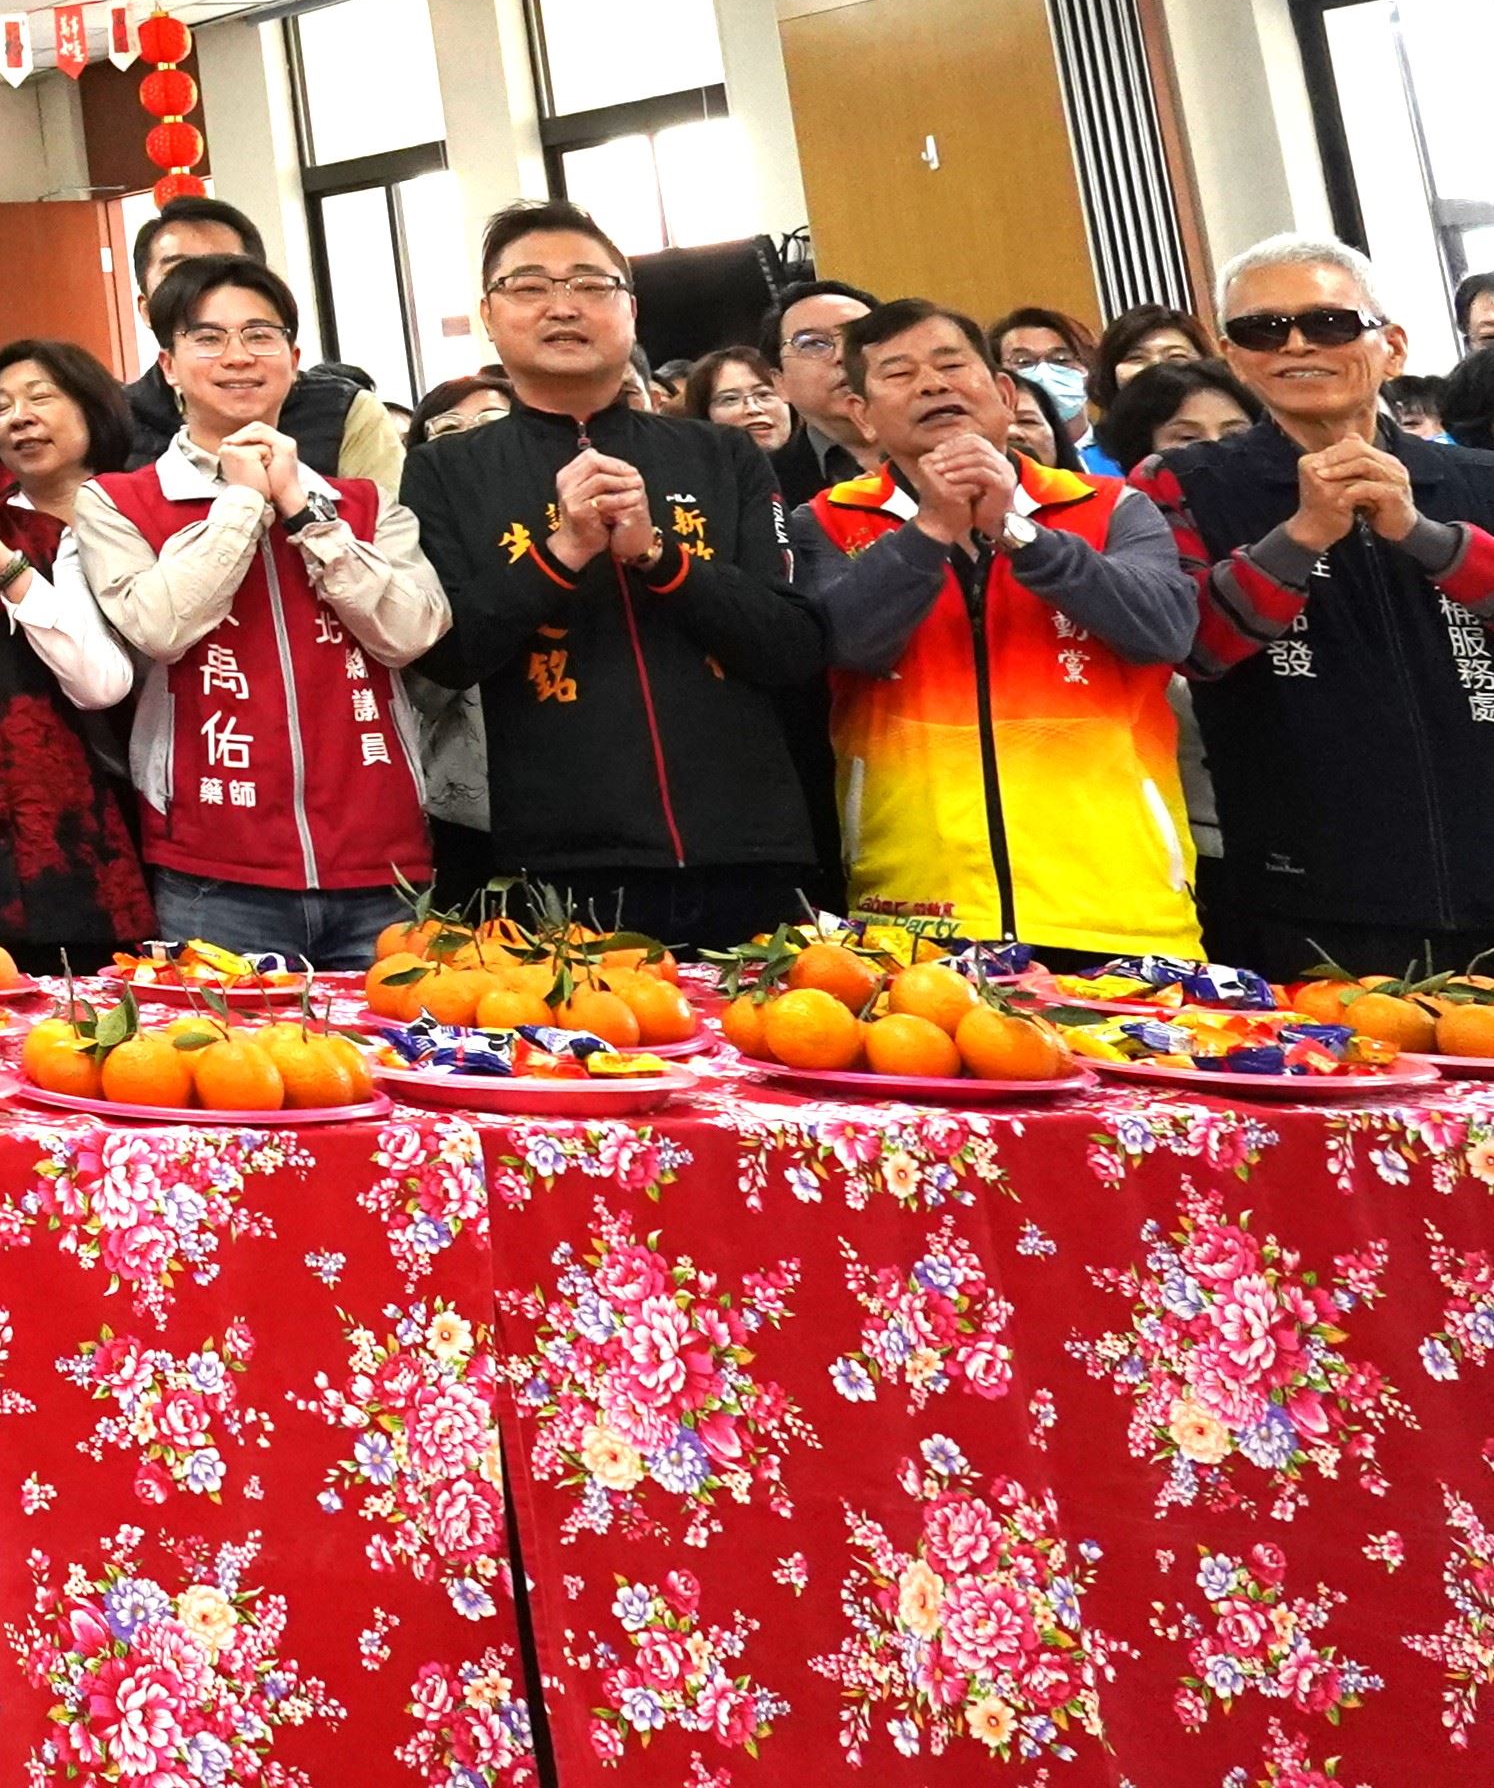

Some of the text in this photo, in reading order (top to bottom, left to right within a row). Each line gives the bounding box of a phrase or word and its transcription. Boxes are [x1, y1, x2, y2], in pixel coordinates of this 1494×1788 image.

[772, 500, 789, 545] ITALIA
[200, 614, 254, 769] 禹佑
[200, 777, 256, 809] 藥師
